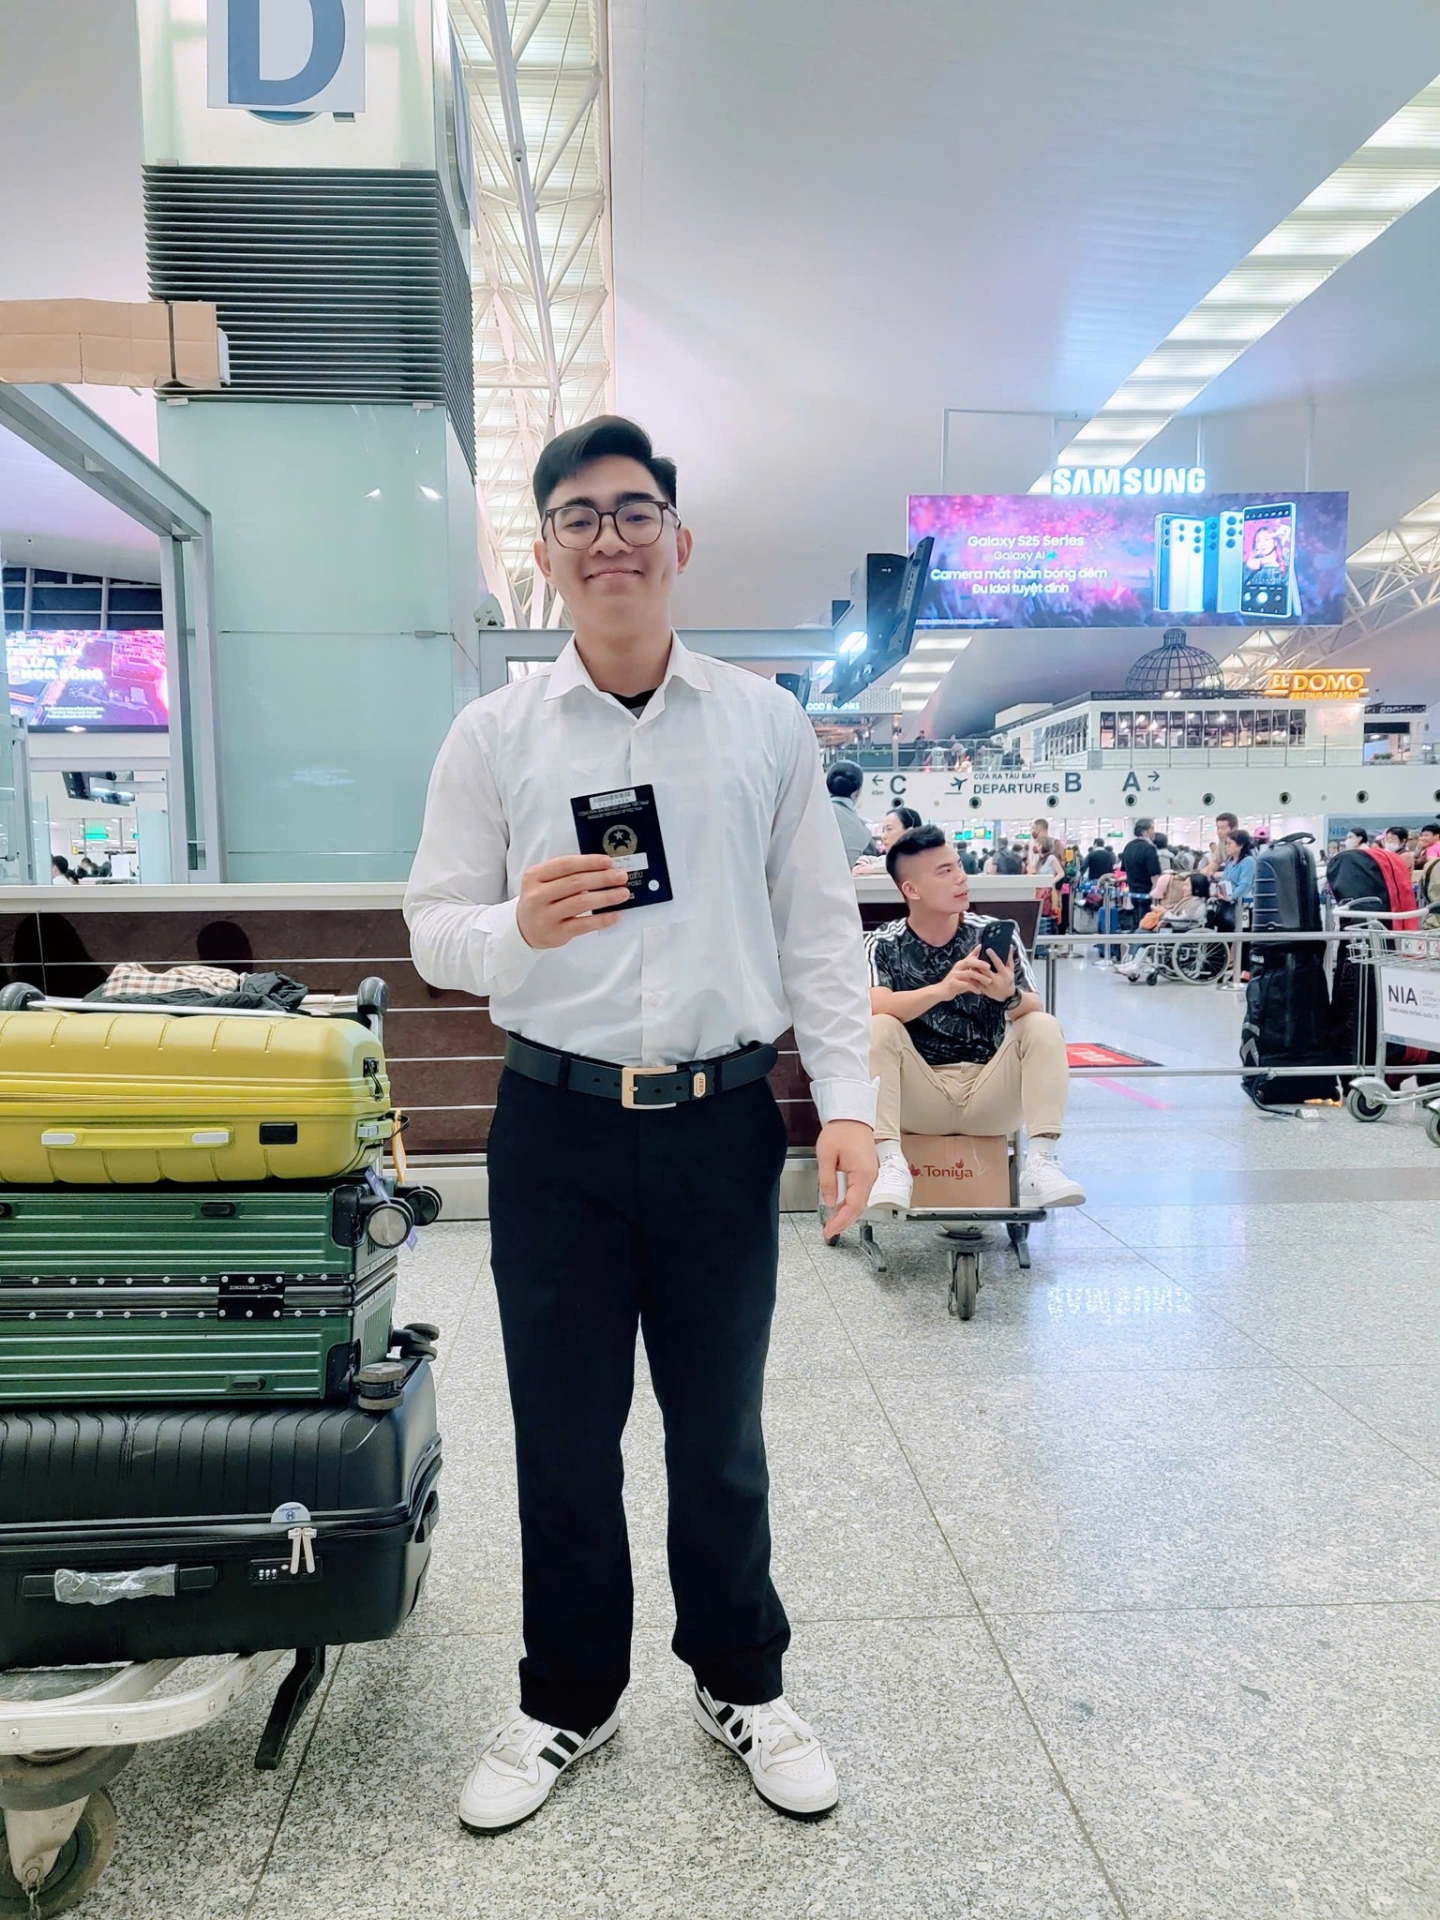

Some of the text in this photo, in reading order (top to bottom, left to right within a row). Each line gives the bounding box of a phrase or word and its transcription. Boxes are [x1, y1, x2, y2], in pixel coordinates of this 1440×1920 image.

[228, 0, 345, 106] D
[1051, 467, 1206, 495] SAMSUNG
[967, 534, 1085, 549] Galaxy S25 Series
[993, 551, 1046, 561] Galaxy AI
[930, 565, 1108, 581] Camera mắt thần bóng đêm
[972, 583, 988, 594] Đu
[989, 583, 1010, 594] Idol
[1012, 581, 1043, 596] tuyệt
[1272, 673, 1364, 691] EL DOMO
[889, 775, 907, 794] C
[973, 783, 1059, 794] DEPARTURES
[1065, 772, 1082, 792] B
[1122, 771, 1141, 791] A
[1388, 984, 1418, 1006] NIA
[923, 1165, 973, 1180] Toniya
